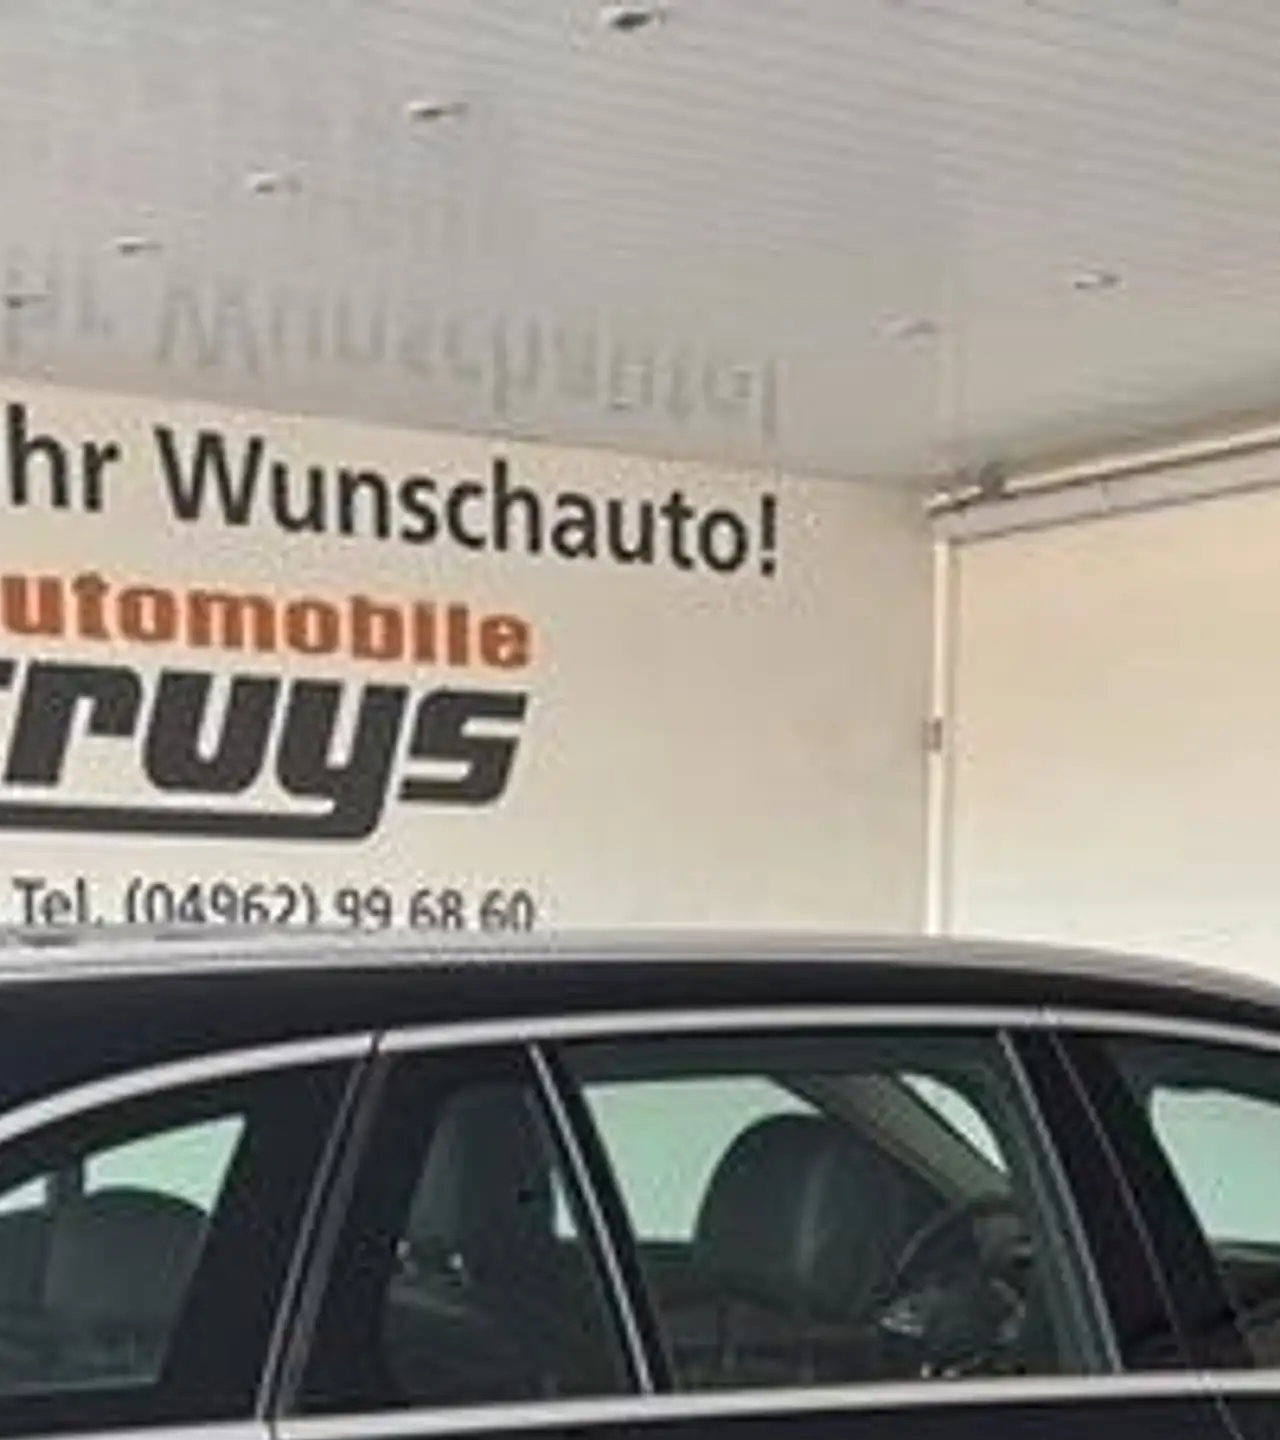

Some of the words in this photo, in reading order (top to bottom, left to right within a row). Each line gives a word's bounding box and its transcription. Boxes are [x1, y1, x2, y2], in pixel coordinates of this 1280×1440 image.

[154, 426, 778, 577] Wunschauto!
[126, 879, 317, 930] (04962)
[335, 890, 392, 931] 99
[409, 889, 463, 931] 68
[479, 890, 534, 932] 60
